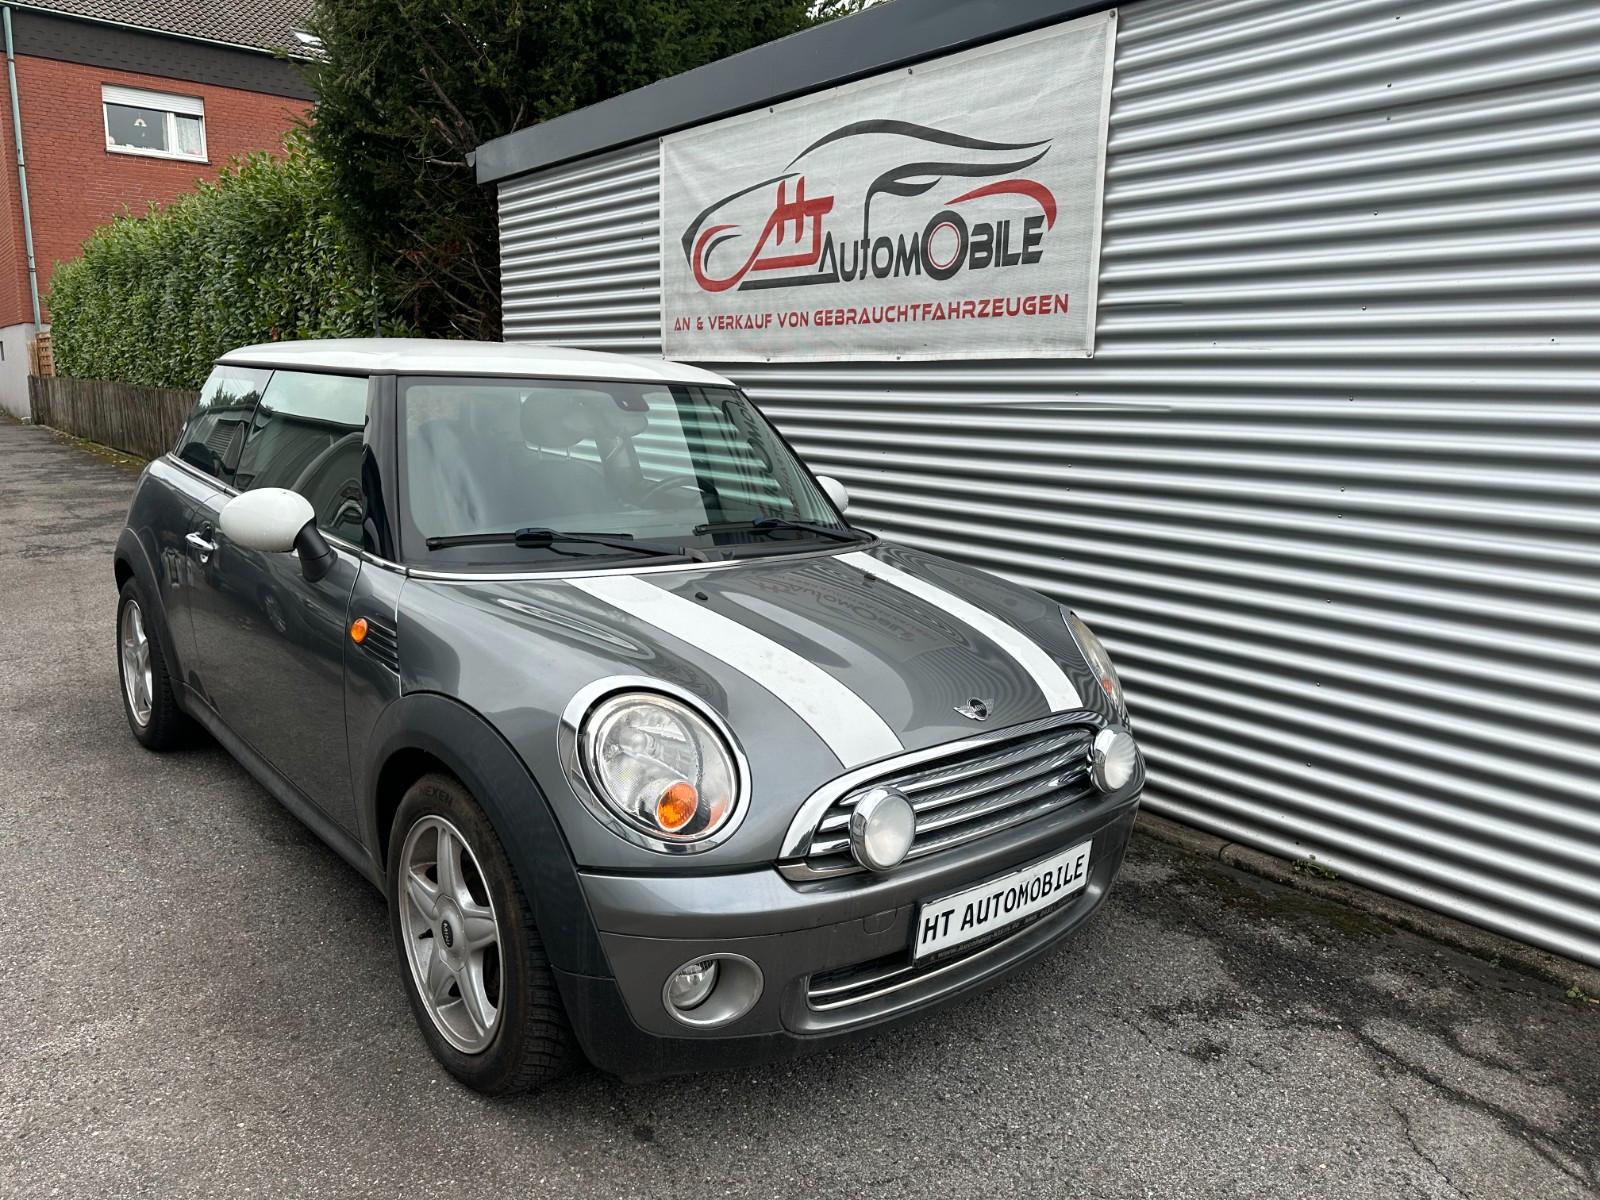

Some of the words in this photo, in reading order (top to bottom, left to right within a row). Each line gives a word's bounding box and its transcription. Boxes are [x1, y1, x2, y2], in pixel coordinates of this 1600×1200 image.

[818, 208, 1046, 282] AUTOMOBILE
[674, 316, 691, 331] AN
[696, 316, 704, 331] &
[708, 313, 773, 330] VERKAUF
[777, 311, 809, 328] VON
[813, 293, 1069, 326] GEBRAUCHTFAHRZEUGEN
[922, 908, 956, 944] HT
[960, 854, 1086, 931] AUTOMOBILE
[442, 922, 451, 946] MINI
